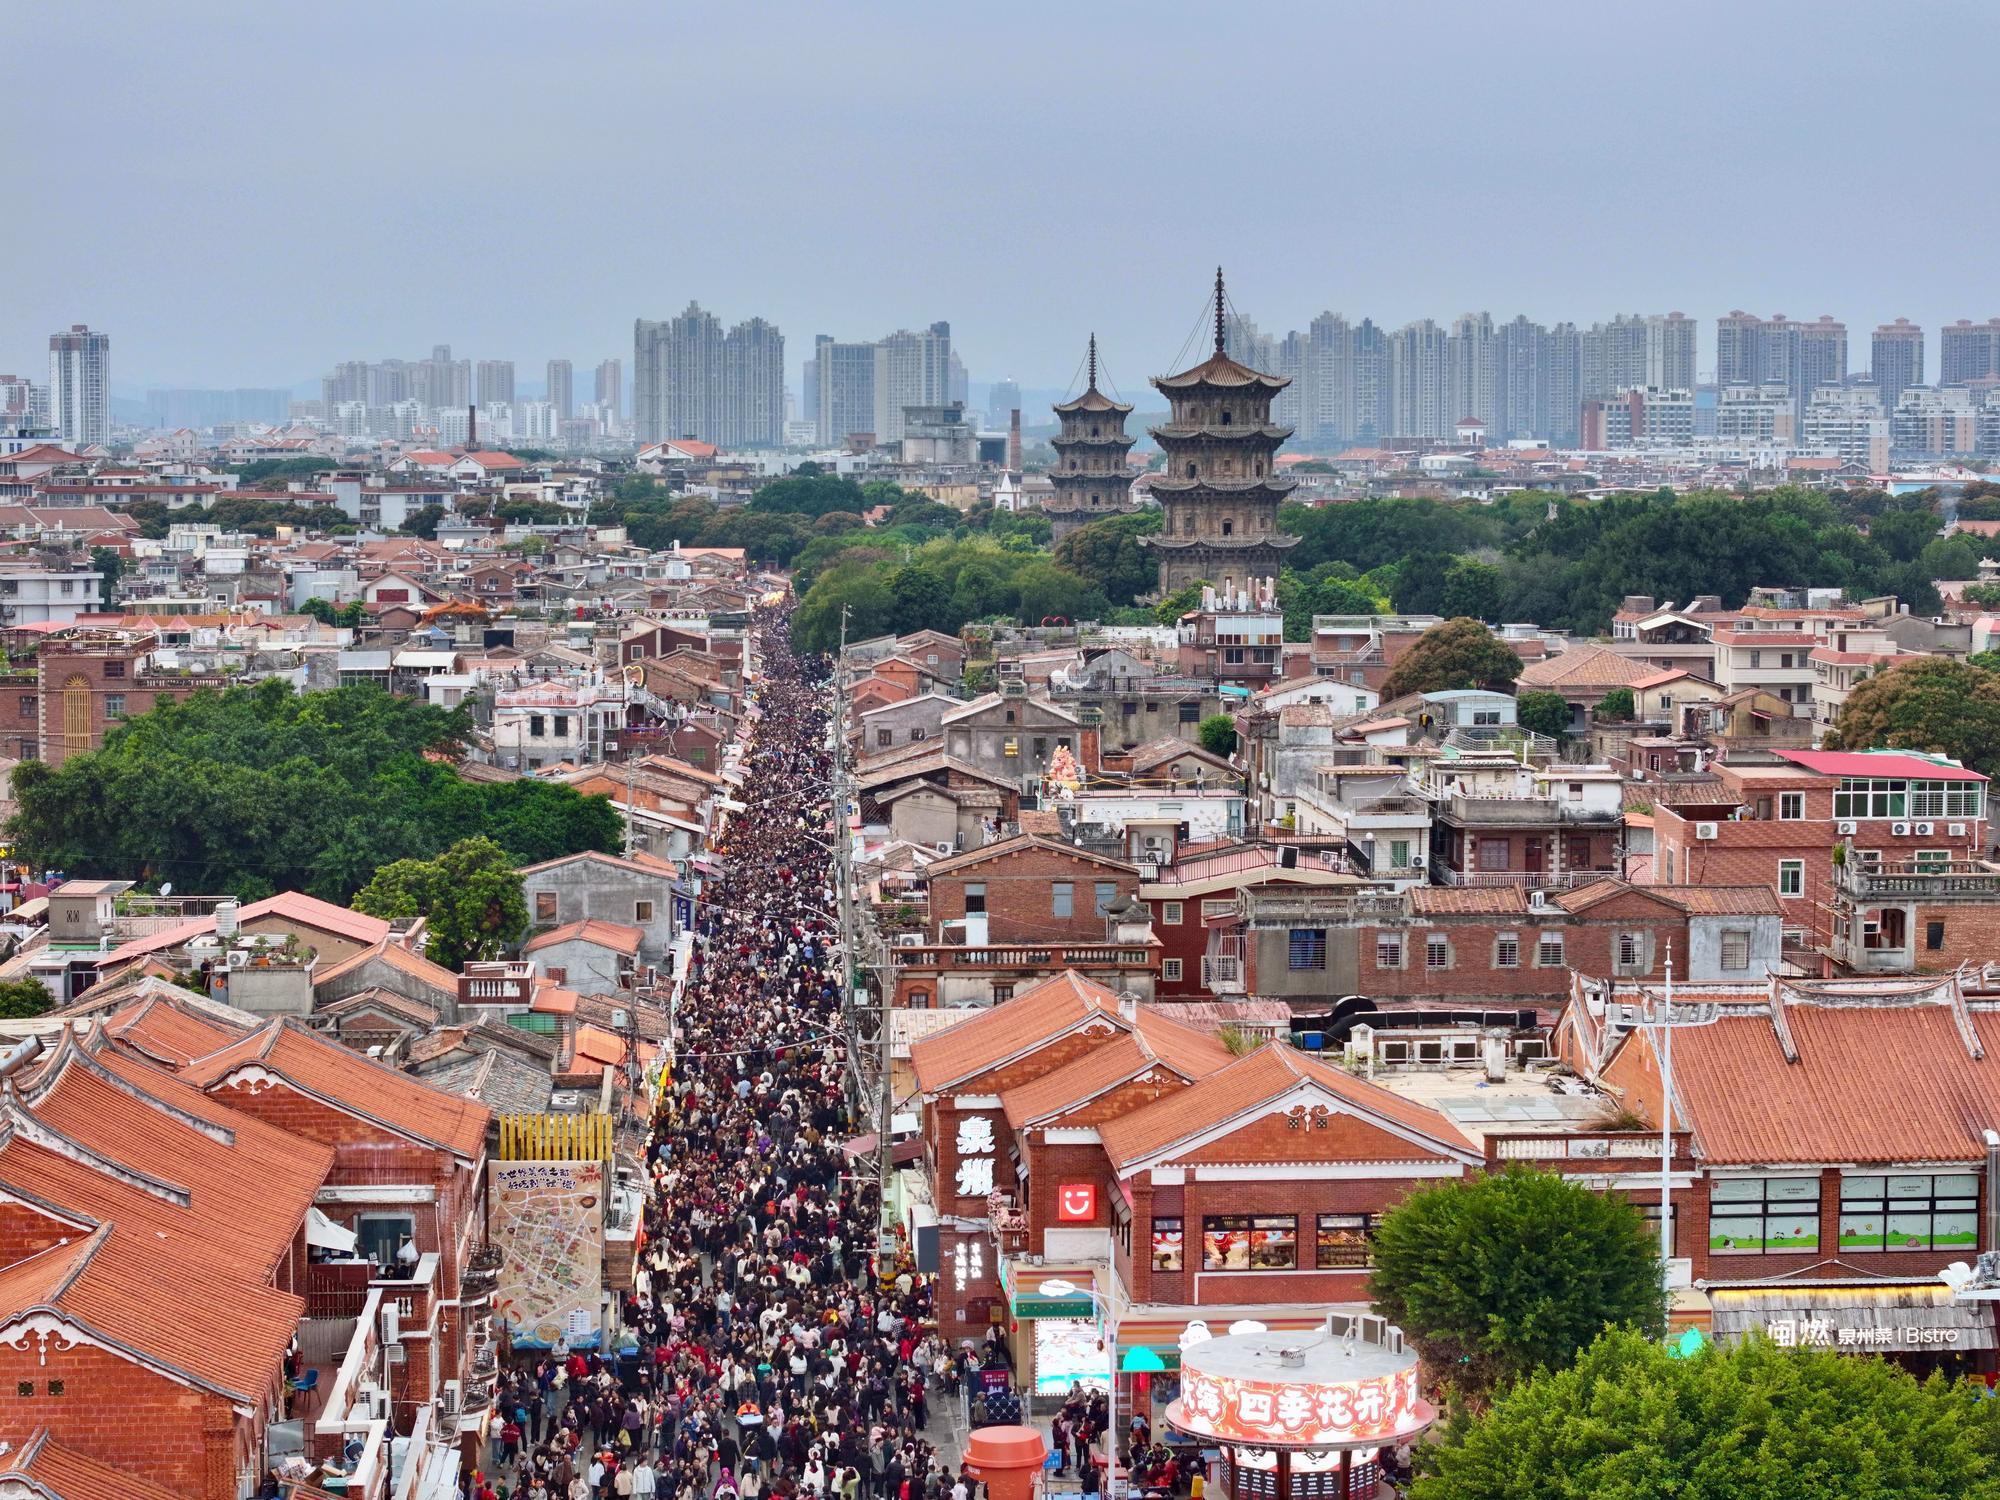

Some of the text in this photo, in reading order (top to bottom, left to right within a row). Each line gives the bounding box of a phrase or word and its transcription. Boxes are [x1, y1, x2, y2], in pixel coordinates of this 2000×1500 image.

[956, 1116, 996, 1195] 泉州
[1767, 1319, 1958, 1347] 闽燃 泉州菜 Bistro
